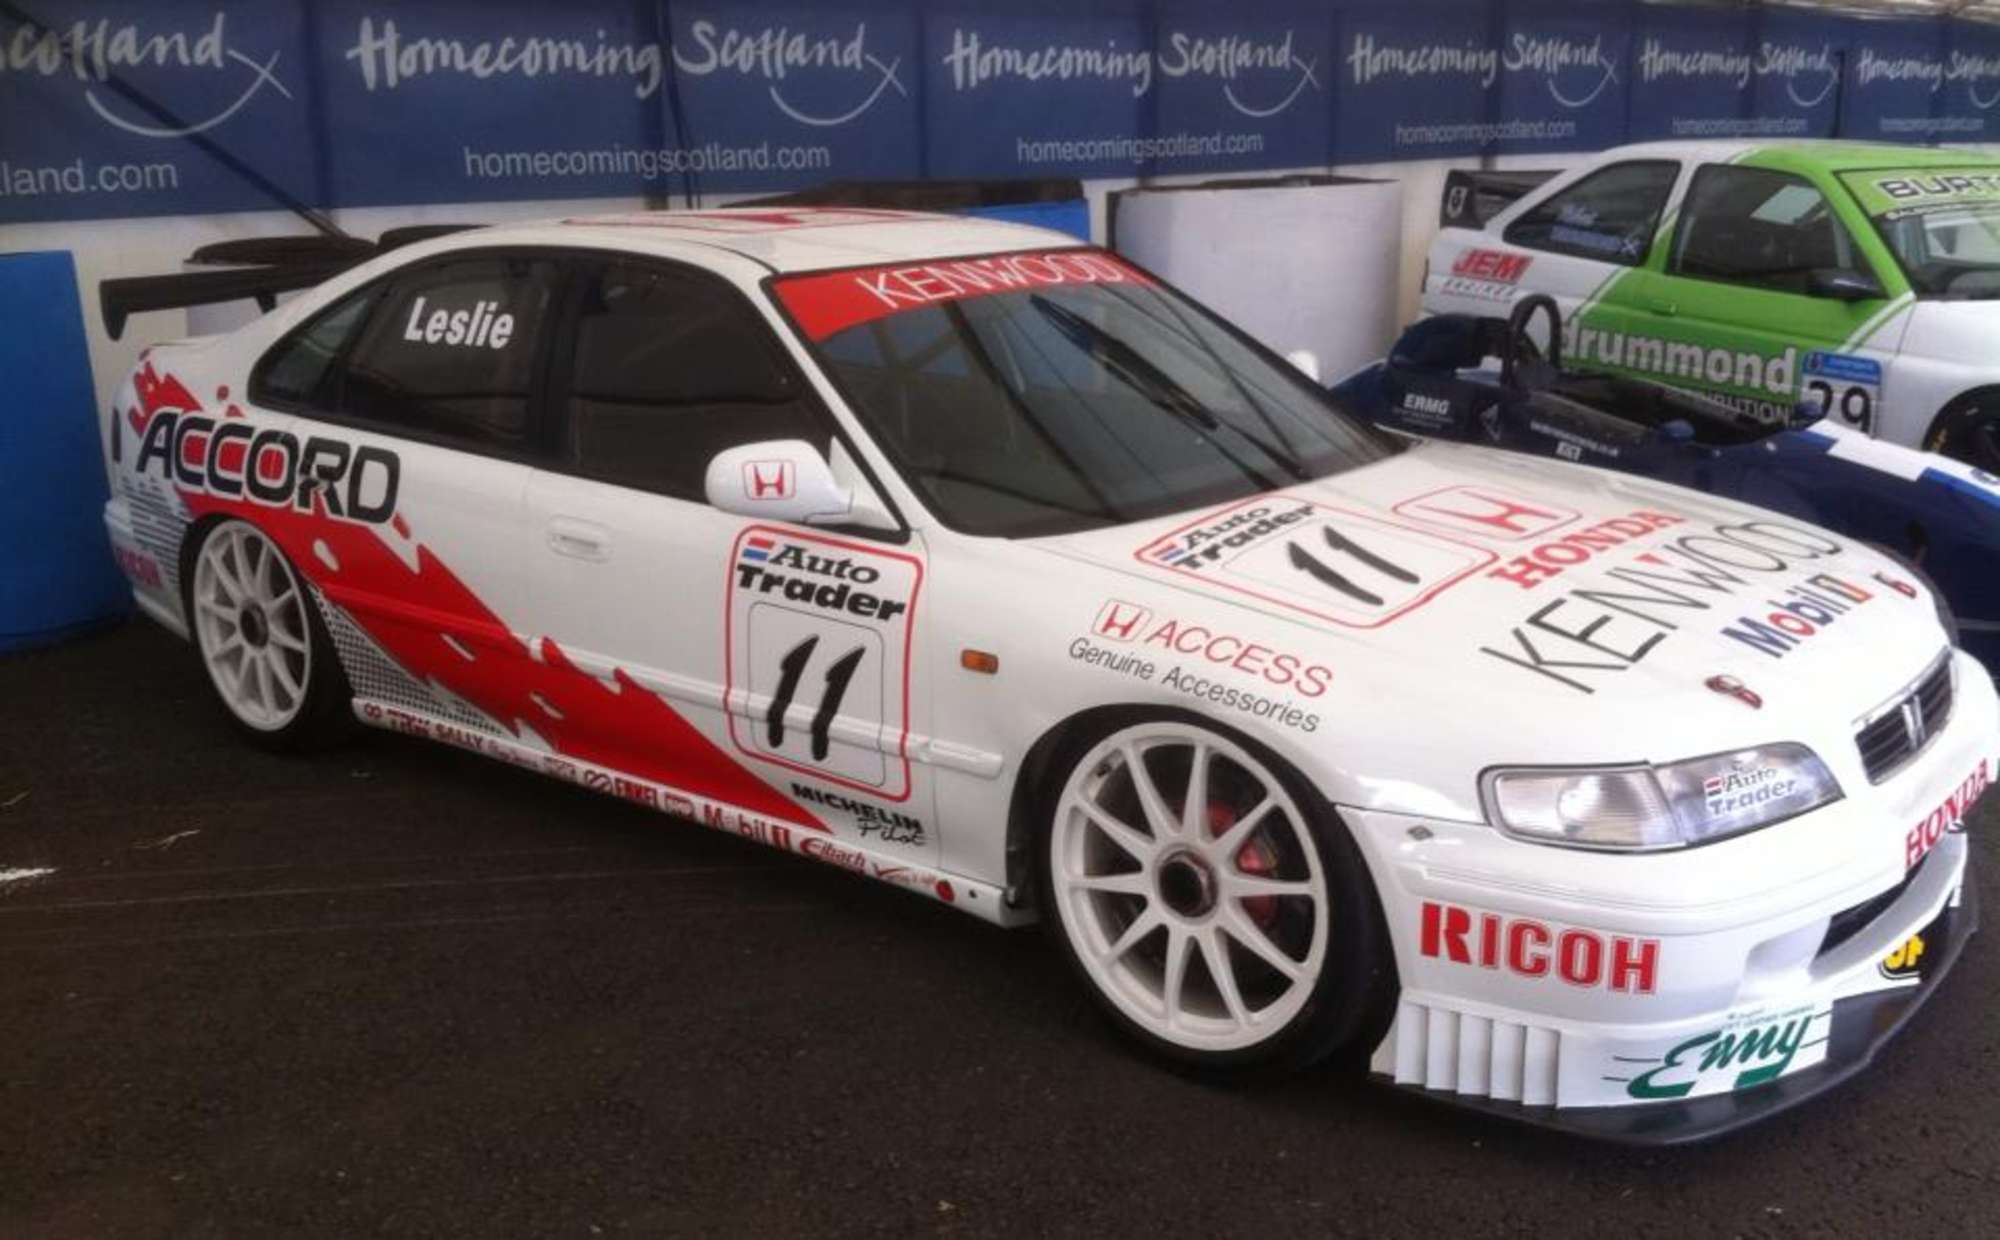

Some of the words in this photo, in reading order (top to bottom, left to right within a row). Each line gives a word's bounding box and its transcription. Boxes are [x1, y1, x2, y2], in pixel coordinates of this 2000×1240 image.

[0, 11, 225, 80] cotland
[347, 16, 662, 98] Homecoming
[672, 21, 864, 80] Scotland
[943, 27, 1152, 97] Homecoming
[1158, 30, 1292, 78] Scotland
[1346, 33, 1496, 89] Homecoming
[1503, 33, 1600, 75] Scotland
[1638, 38, 1750, 90] Homecoming
[1754, 42, 1829, 77] Scotland
[1017, 131, 1263, 165] homecomingscotland.com
[1395, 117, 1576, 146] homecomingscotland.com
[464, 143, 830, 180] homecomingscotland.com
[856, 253, 1124, 309] KENWOOD
[1452, 249, 1535, 285] JEM
[404, 297, 514, 349] Leslie
[1561, 319, 1797, 394] drummond
[1403, 393, 1450, 415] ERMG
[136, 410, 401, 524] ACCORD
[1172, 503, 1315, 570] Trader
[1182, 507, 1272, 550] Auto
[1487, 511, 1686, 589] HONDA
[769, 544, 879, 583] Auto
[1288, 525, 1420, 606] 11
[737, 564, 905, 621] Trader
[1480, 521, 1842, 694] KENWOOD
[1721, 582, 1851, 658] Mobil
[1068, 637, 1154, 681] Genuine
[1161, 666, 1321, 733] Accessories
[1146, 620, 1334, 698] ACCESS
[767, 635, 866, 761] 11
[1708, 779, 1798, 815] Trader
[1725, 767, 1778, 791] Auto
[791, 783, 924, 835] MICHELIN
[858, 816, 927, 846] Pilot
[1905, 757, 1989, 868] HONDA
[800, 837, 866, 876] Eibach
[1419, 900, 1662, 996] RICOH
